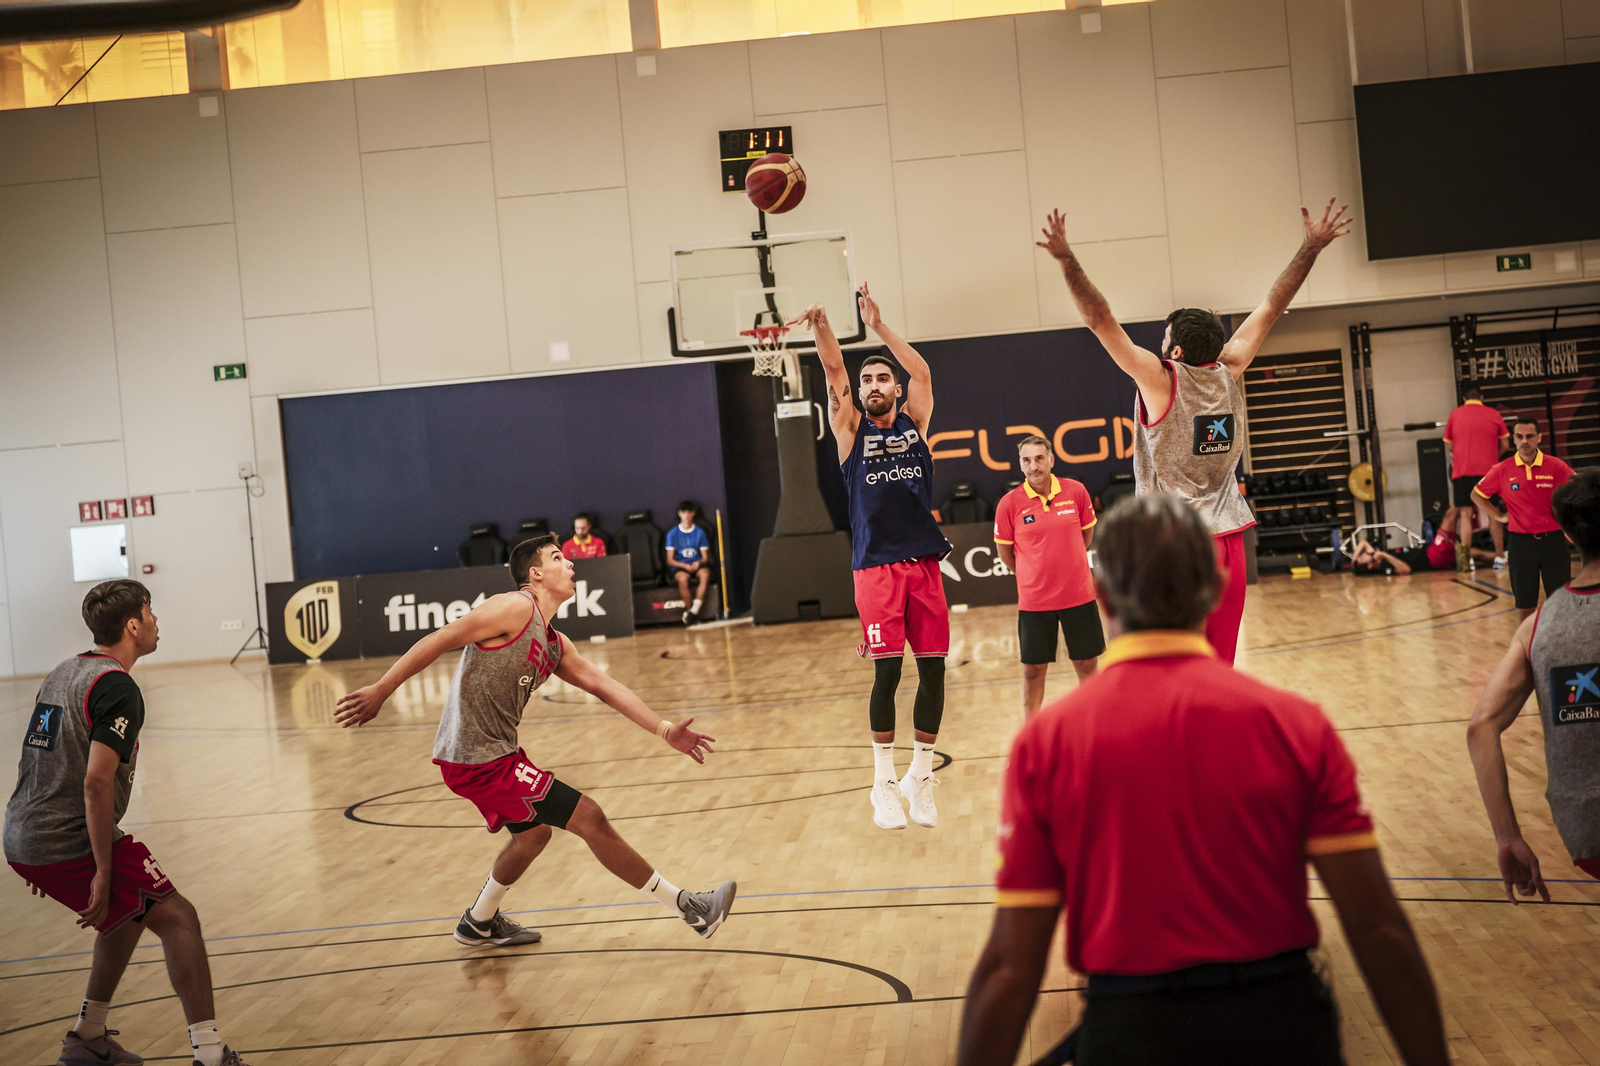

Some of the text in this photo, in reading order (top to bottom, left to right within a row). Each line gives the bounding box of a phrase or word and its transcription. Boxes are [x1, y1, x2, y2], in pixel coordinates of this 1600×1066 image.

[749, 130, 783, 149] 1:11
[863, 428, 919, 457] ESP
[866, 465, 922, 485] endesa
[315, 585, 334, 595] FEB
[384, 580, 606, 632] finerk
[295, 599, 329, 645] 100
[1558, 706, 1600, 722] CaixaBa
